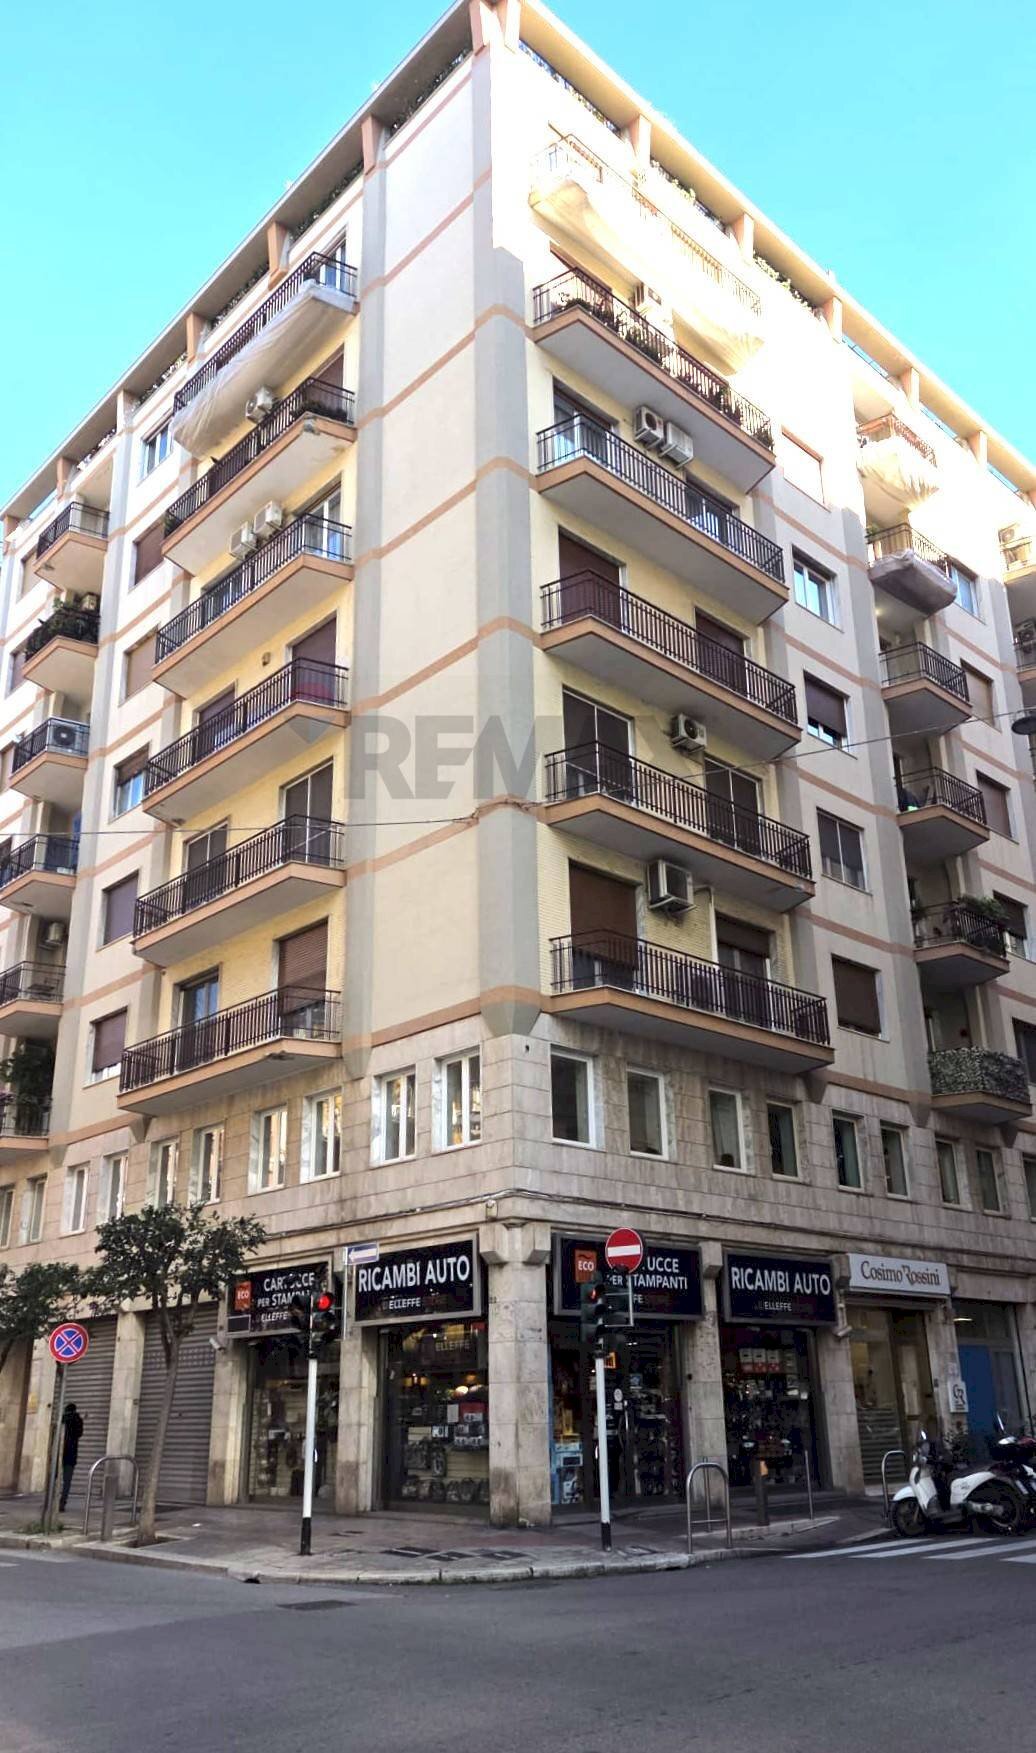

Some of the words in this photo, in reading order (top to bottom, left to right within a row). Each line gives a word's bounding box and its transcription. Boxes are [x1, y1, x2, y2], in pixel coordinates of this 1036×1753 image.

[578, 1260, 594, 1271] ECO
[358, 1261, 420, 1293] RICAMBI
[425, 1255, 470, 1285] AUTO
[860, 1260, 903, 1282] Cosimo
[902, 1264, 940, 1285] Rossini
[628, 1274, 688, 1290] TAMPANTI
[731, 1266, 790, 1293] RICAMBI
[794, 1272, 831, 1296] AUTO
[237, 1290, 249, 1300] ECO
[257, 1297, 270, 1308] PER
[389, 1297, 421, 1310] ELLEFFE
[764, 1301, 792, 1312] ELLEFFE
[261, 1312, 288, 1322] ELLEFFE
